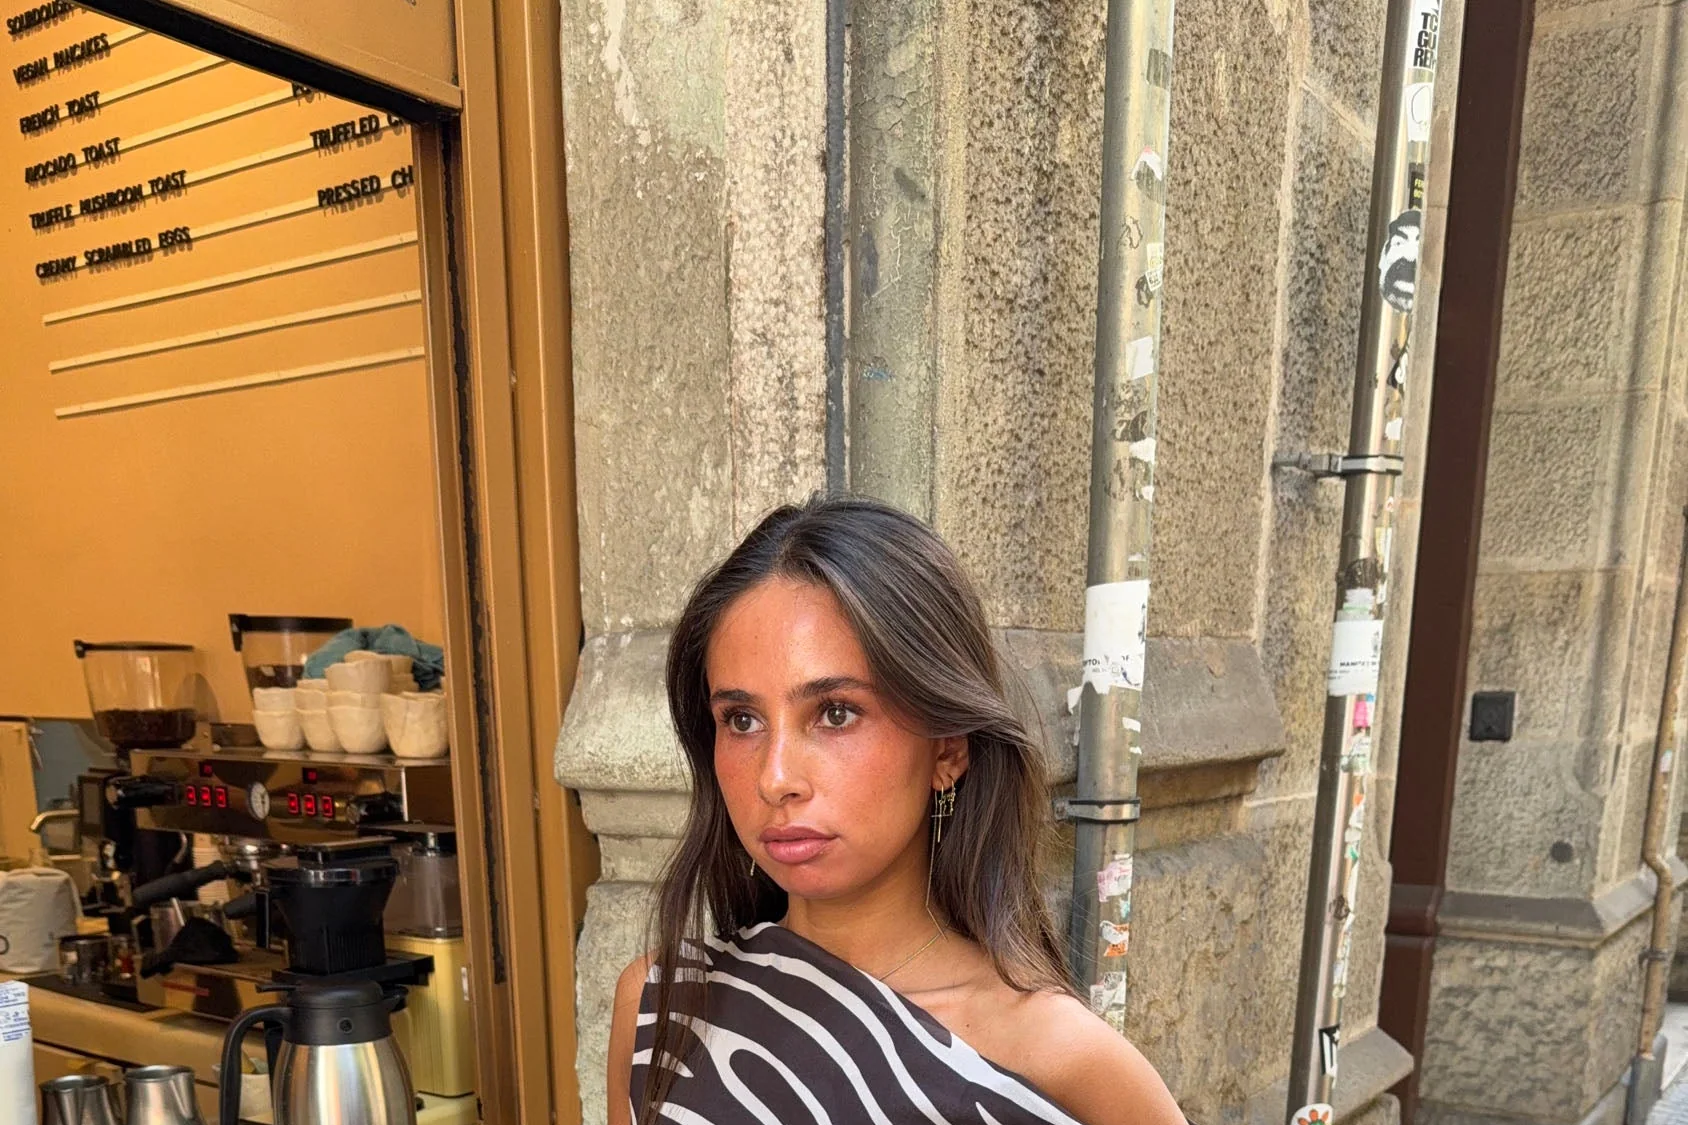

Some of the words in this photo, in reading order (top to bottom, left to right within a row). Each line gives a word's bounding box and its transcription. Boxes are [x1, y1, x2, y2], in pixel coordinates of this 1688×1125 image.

[13, 57, 49, 84] VEGAN
[53, 33, 110, 69] PANCAKES
[20, 104, 60, 134] FRENCH
[65, 91, 100, 117] TOAST
[309, 114, 381, 150] TRUFFLED
[25, 153, 77, 183] AVOCADO
[81, 137, 120, 163] TOAST
[29, 204, 75, 229] TRUFFLE
[79, 184, 145, 215] MUSHROOM
[148, 169, 187, 195] TOAST
[317, 175, 382, 208] PRESSED
[35, 256, 78, 278] CREAMY
[84, 238, 152, 266] SCRAMBLED
[158, 226, 192, 248] EGGS
